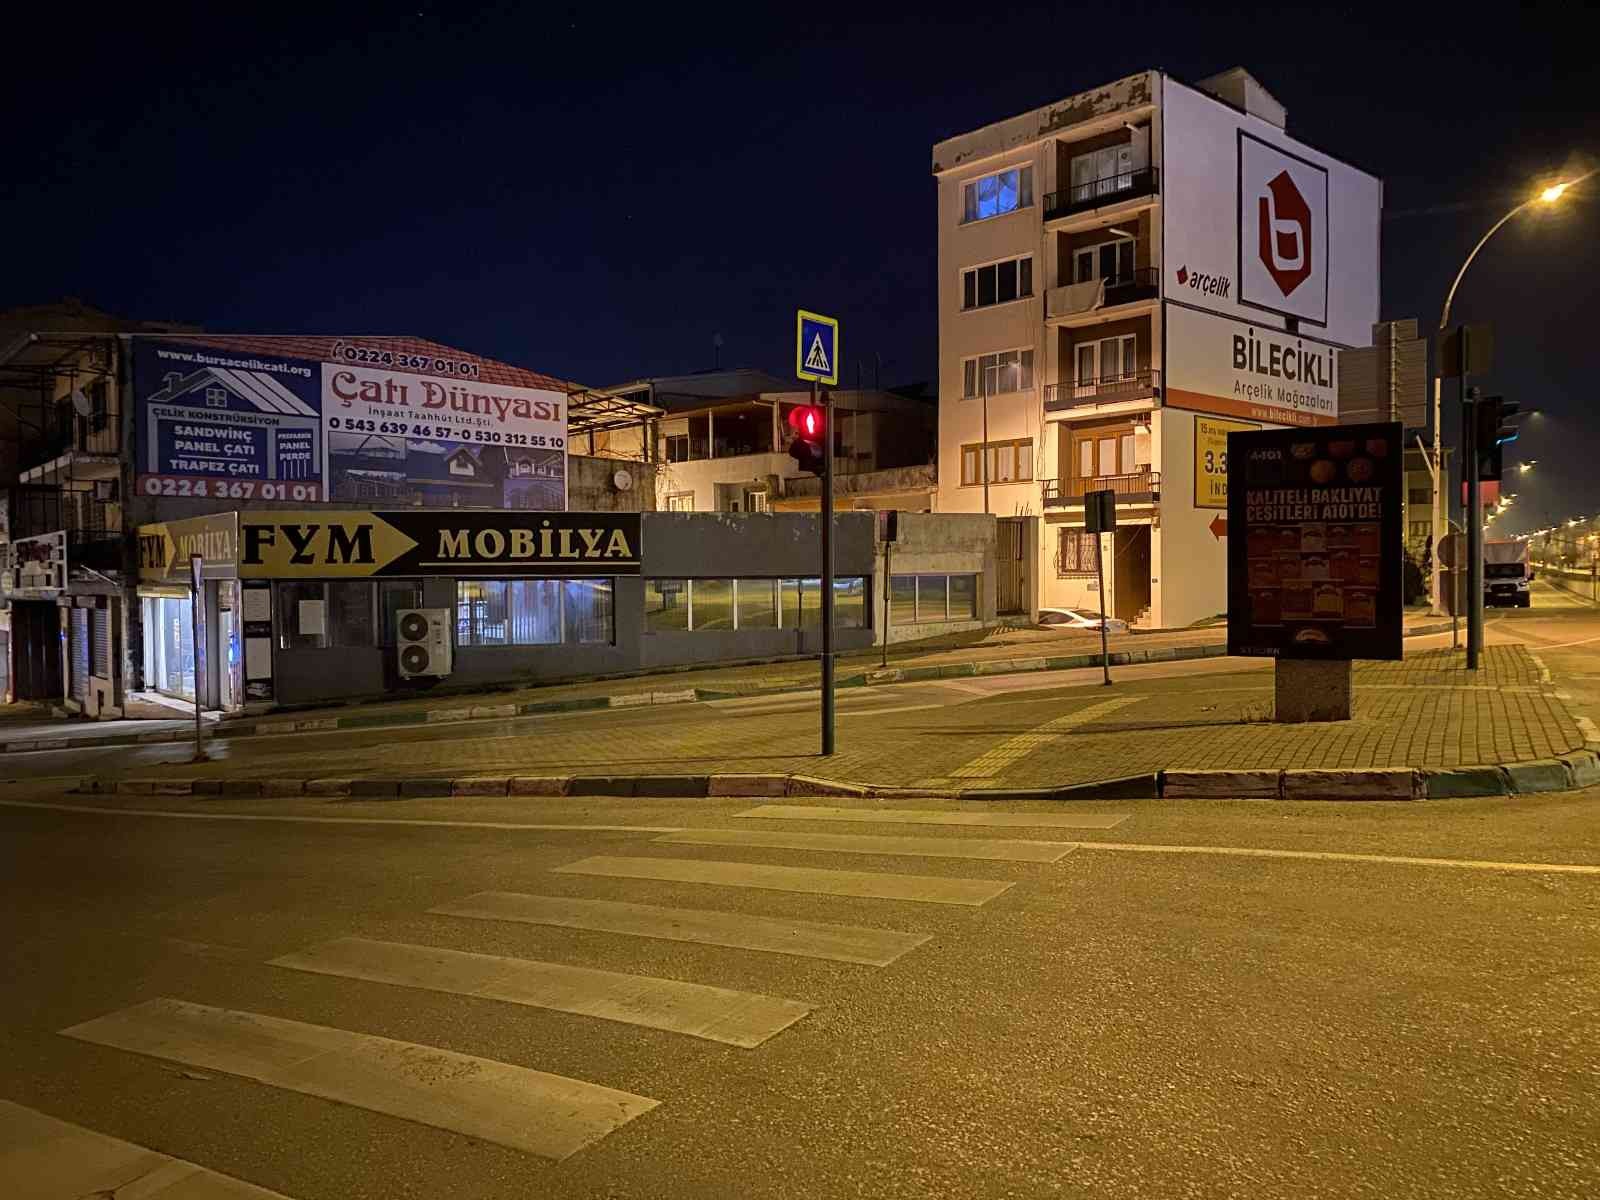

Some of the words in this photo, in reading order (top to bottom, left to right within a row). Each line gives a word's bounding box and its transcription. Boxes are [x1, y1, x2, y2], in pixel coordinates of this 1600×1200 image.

[1189, 270, 1231, 299] arçelik
[156, 349, 312, 377] www.bursacelikcati.org
[344, 347, 393, 366] 0224
[398, 352, 429, 370] 367
[434, 359, 456, 374] 01
[459, 362, 480, 377] 01
[1233, 327, 1333, 388] BİLECİKLİ
[331, 370, 408, 409] Çatı
[420, 380, 560, 422] Dünyası
[1234, 379, 1273, 401] Arçelik
[1277, 387, 1333, 410] Mağazaları
[152, 406, 185, 419] ÇELİK
[408, 410, 452, 422] Taahhüt
[174, 425, 252, 443] SANDWİNÇ
[329, 417, 340, 429] 0
[345, 418, 376, 432] 543
[380, 420, 408, 434] 639
[412, 423, 431, 437] 46
[475, 429, 501, 443] 530
[505, 432, 527, 445] 312
[530, 435, 547, 447] 55
[550, 437, 564, 448] 10
[175, 440, 221, 453] PANEL
[224, 444, 255, 456] ÇATI
[169, 459, 226, 472] TRAPEZ
[229, 463, 260, 476] ÇATI
[145, 478, 208, 497] 0224
[215, 480, 255, 499] 367
[261, 482, 286, 500] 01
[293, 484, 317, 502] 01
[139, 533, 167, 569] FYM
[179, 525, 233, 562] MOBİLYA
[241, 524, 376, 564] FYM
[437, 520, 633, 559] MOBİLYA
